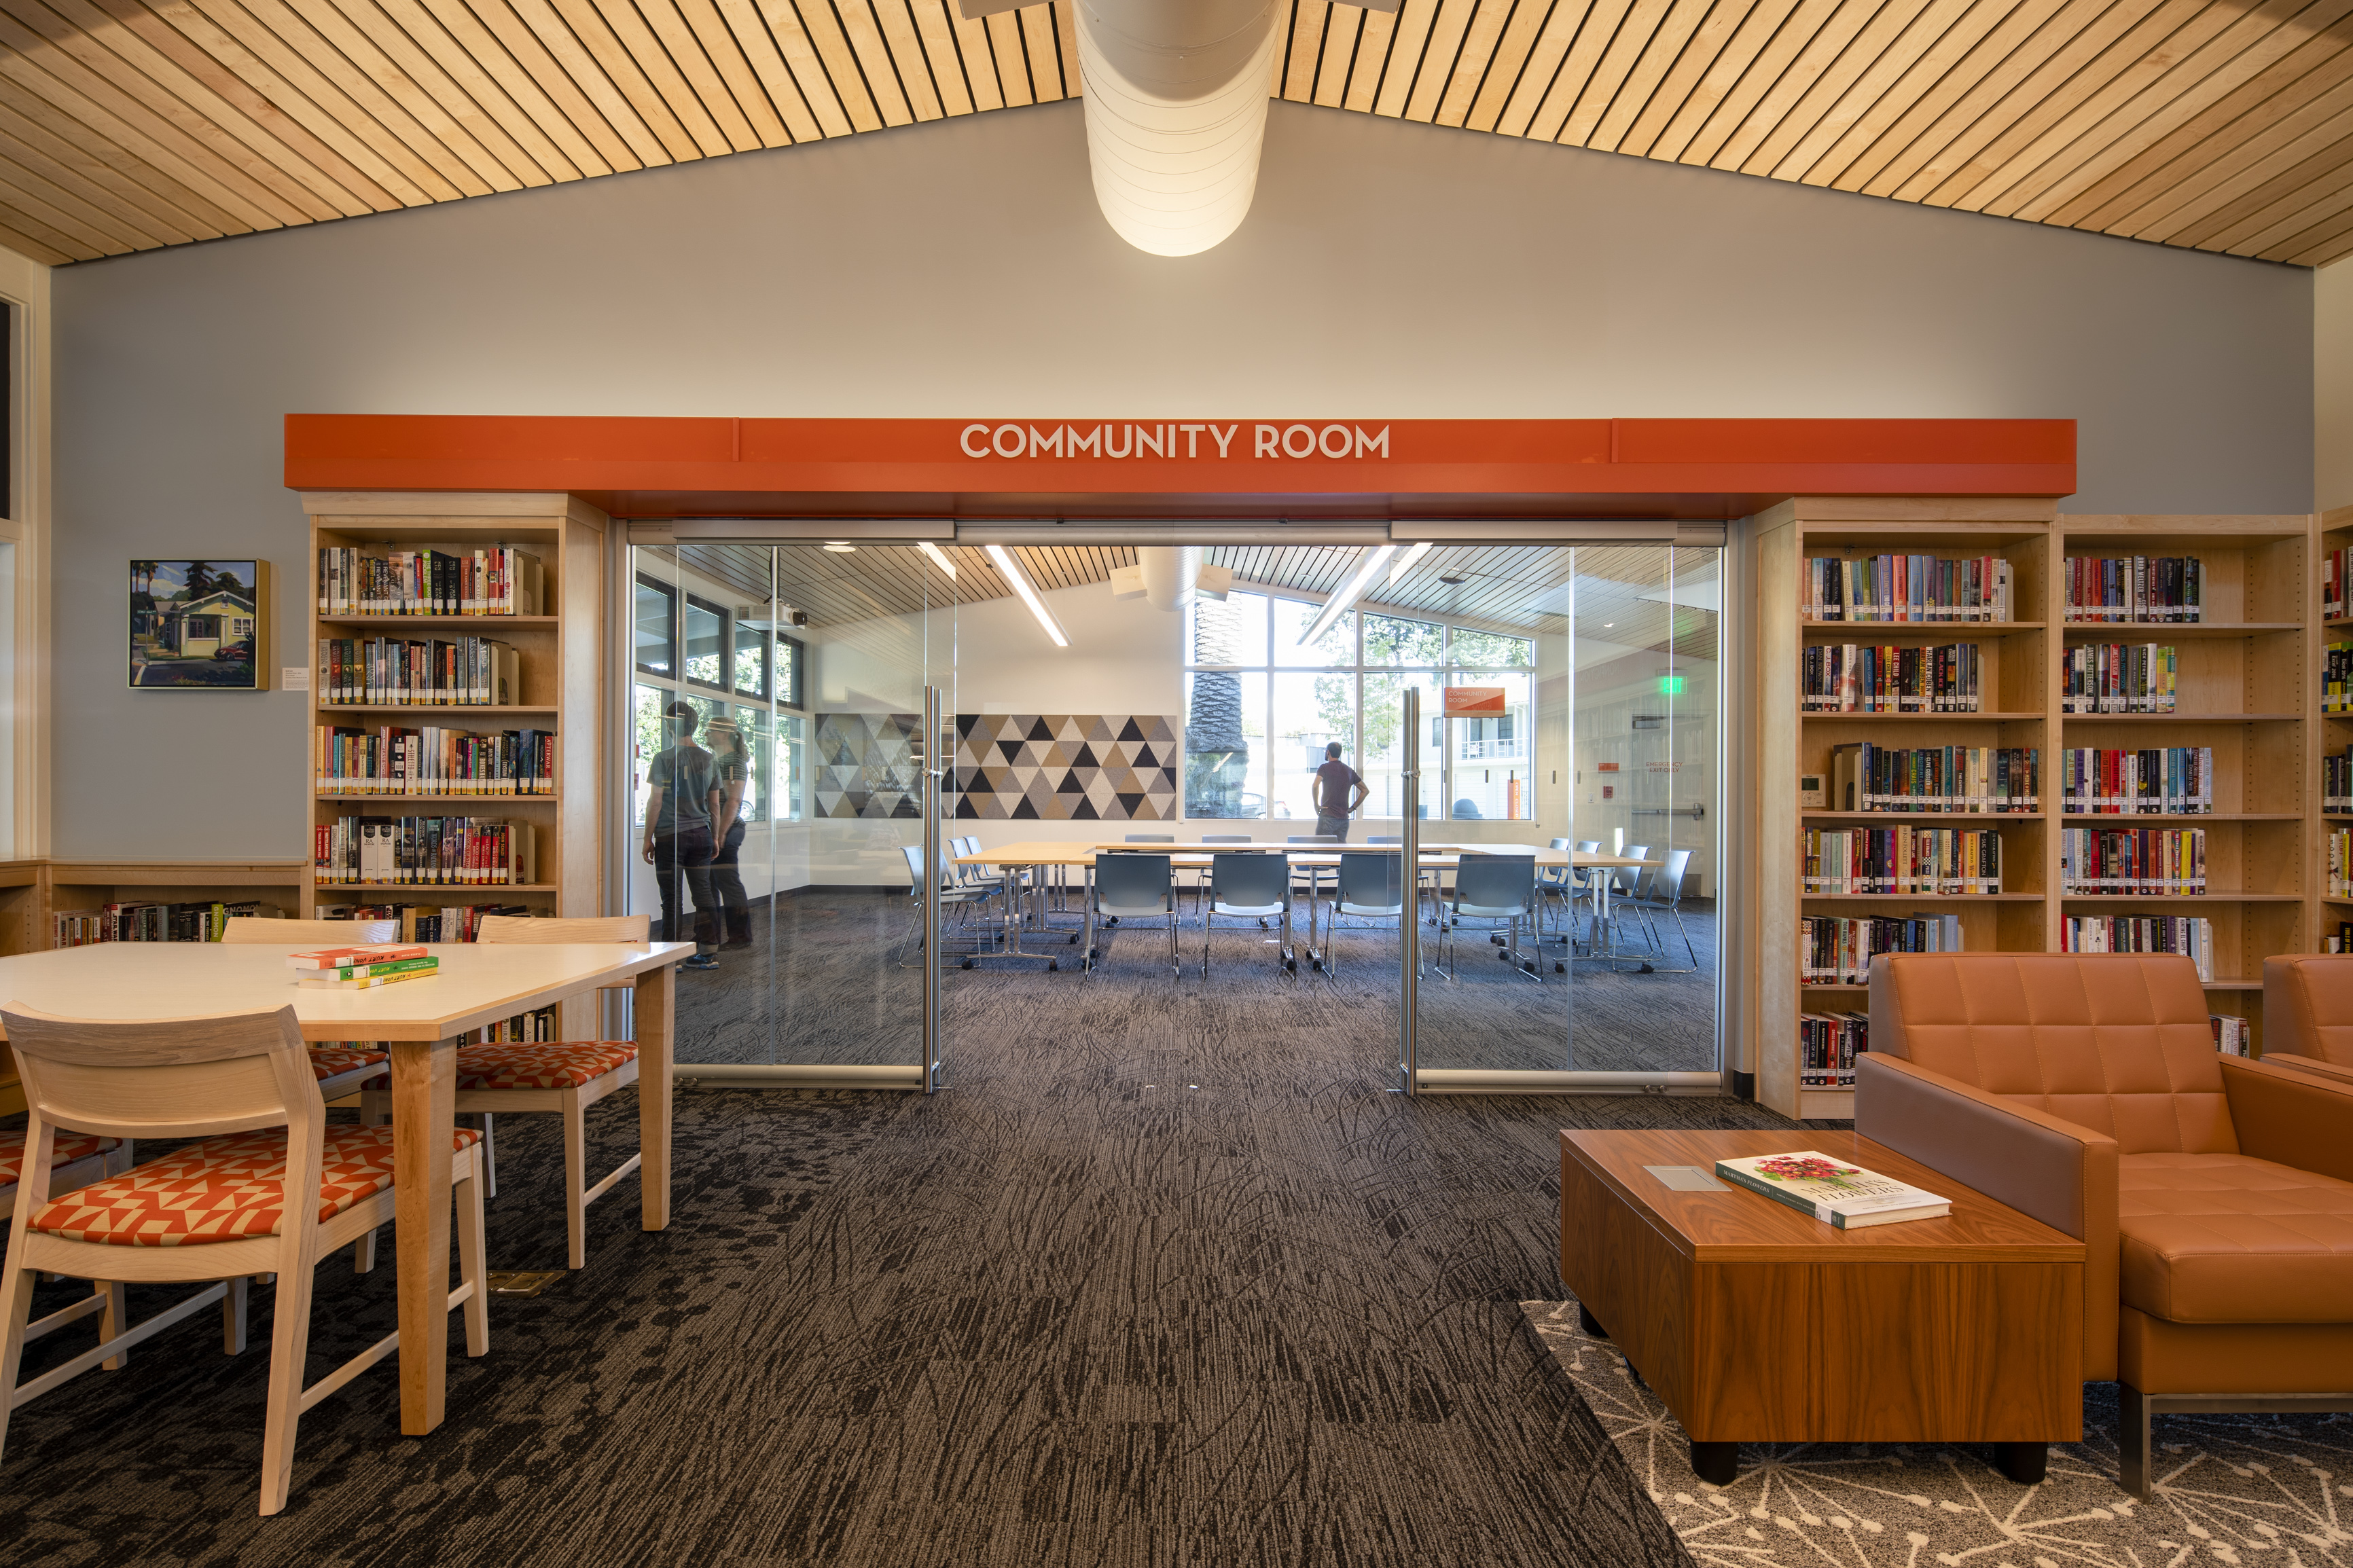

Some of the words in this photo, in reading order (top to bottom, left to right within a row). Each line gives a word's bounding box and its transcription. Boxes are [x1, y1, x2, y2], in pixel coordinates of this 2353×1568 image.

[960, 424, 1238, 458] COMMUNITY
[1255, 424, 1389, 458] ROOM
[1664, 678, 1683, 693] EXIT
[1723, 1169, 1746, 1184] MARTHA'S
[1747, 1180, 1770, 1193] FLOWERS
[1801, 1179, 1890, 1195] MARTHA'S
[1818, 1185, 1905, 1201] FLOWERS
